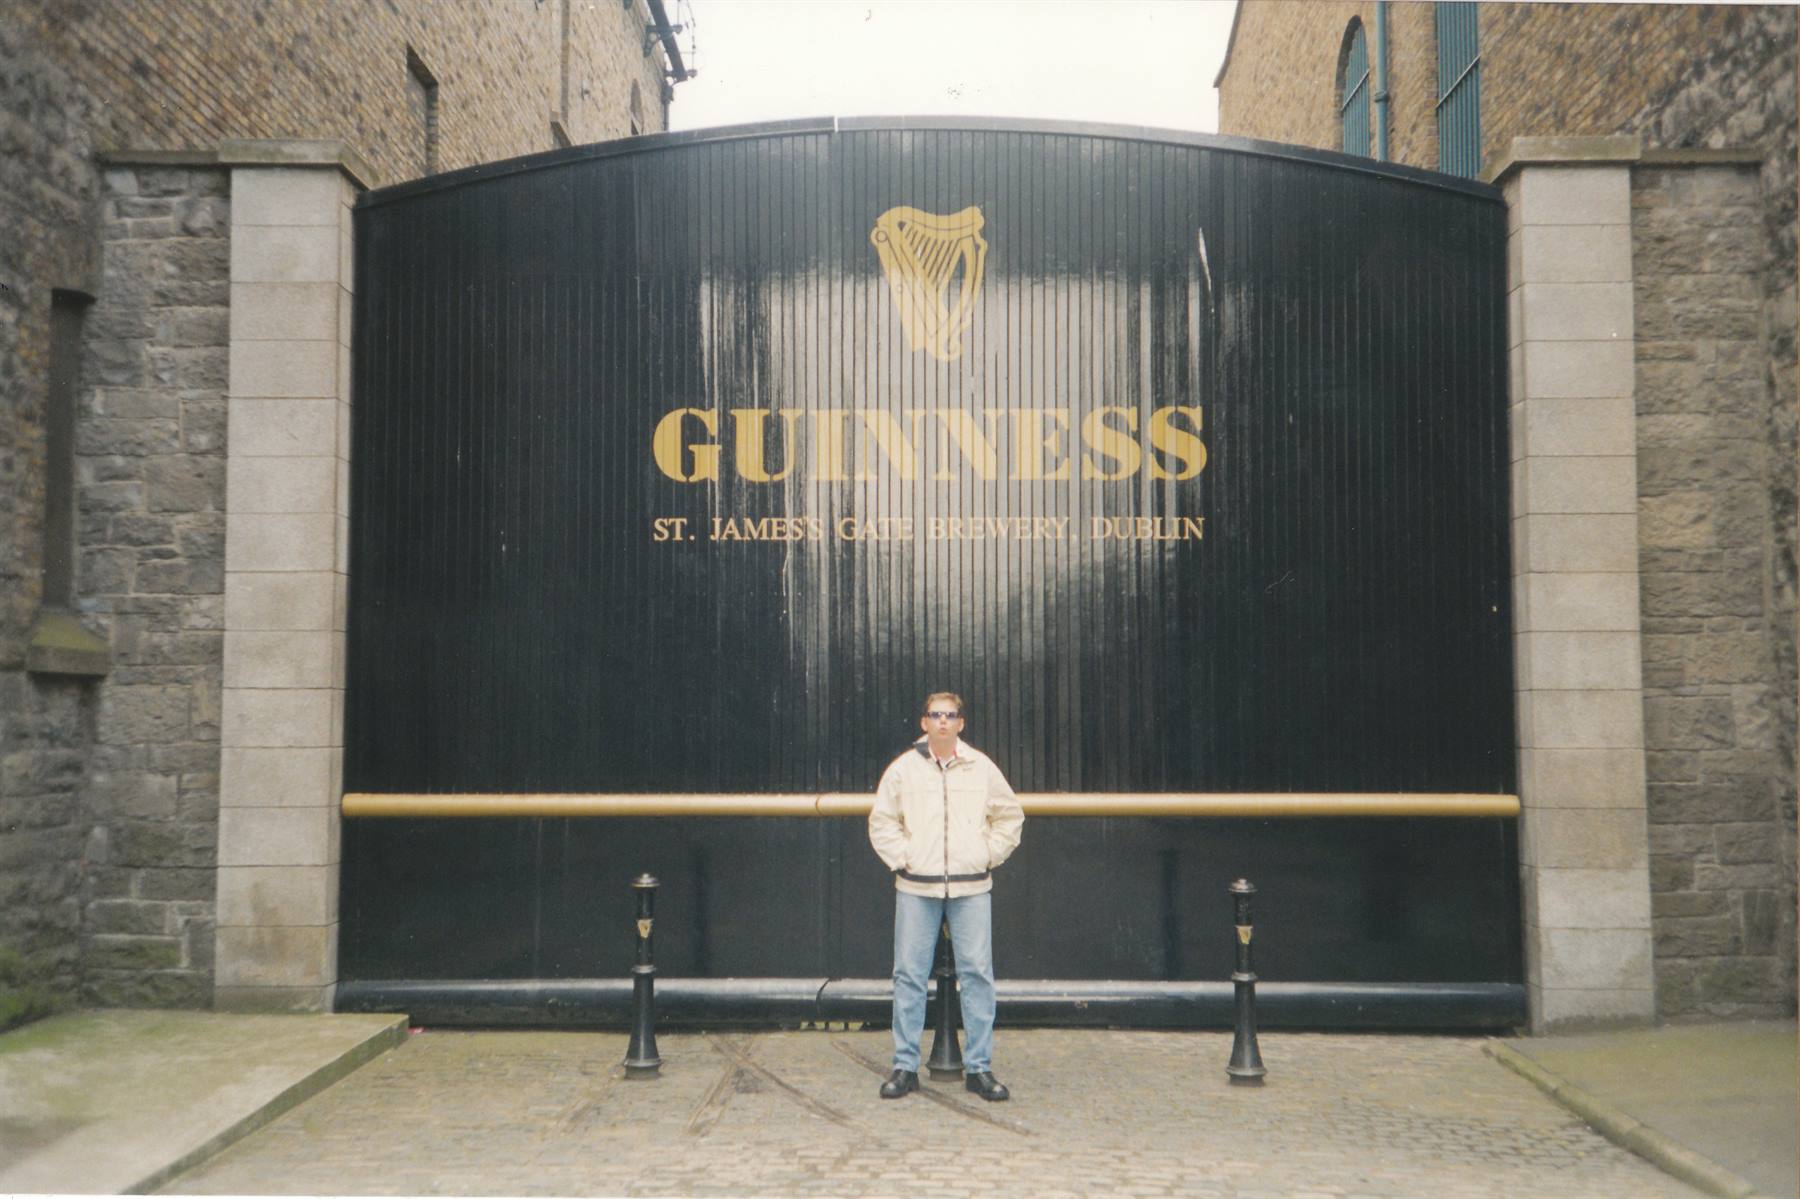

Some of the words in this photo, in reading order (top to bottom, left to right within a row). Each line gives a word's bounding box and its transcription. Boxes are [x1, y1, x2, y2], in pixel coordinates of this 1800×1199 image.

[653, 405, 1208, 482] GUINNESS
[653, 517, 695, 541] ST.
[709, 516, 824, 541] JAMES'S
[837, 518, 914, 541] GATE
[1091, 517, 1205, 541] DUBLIN
